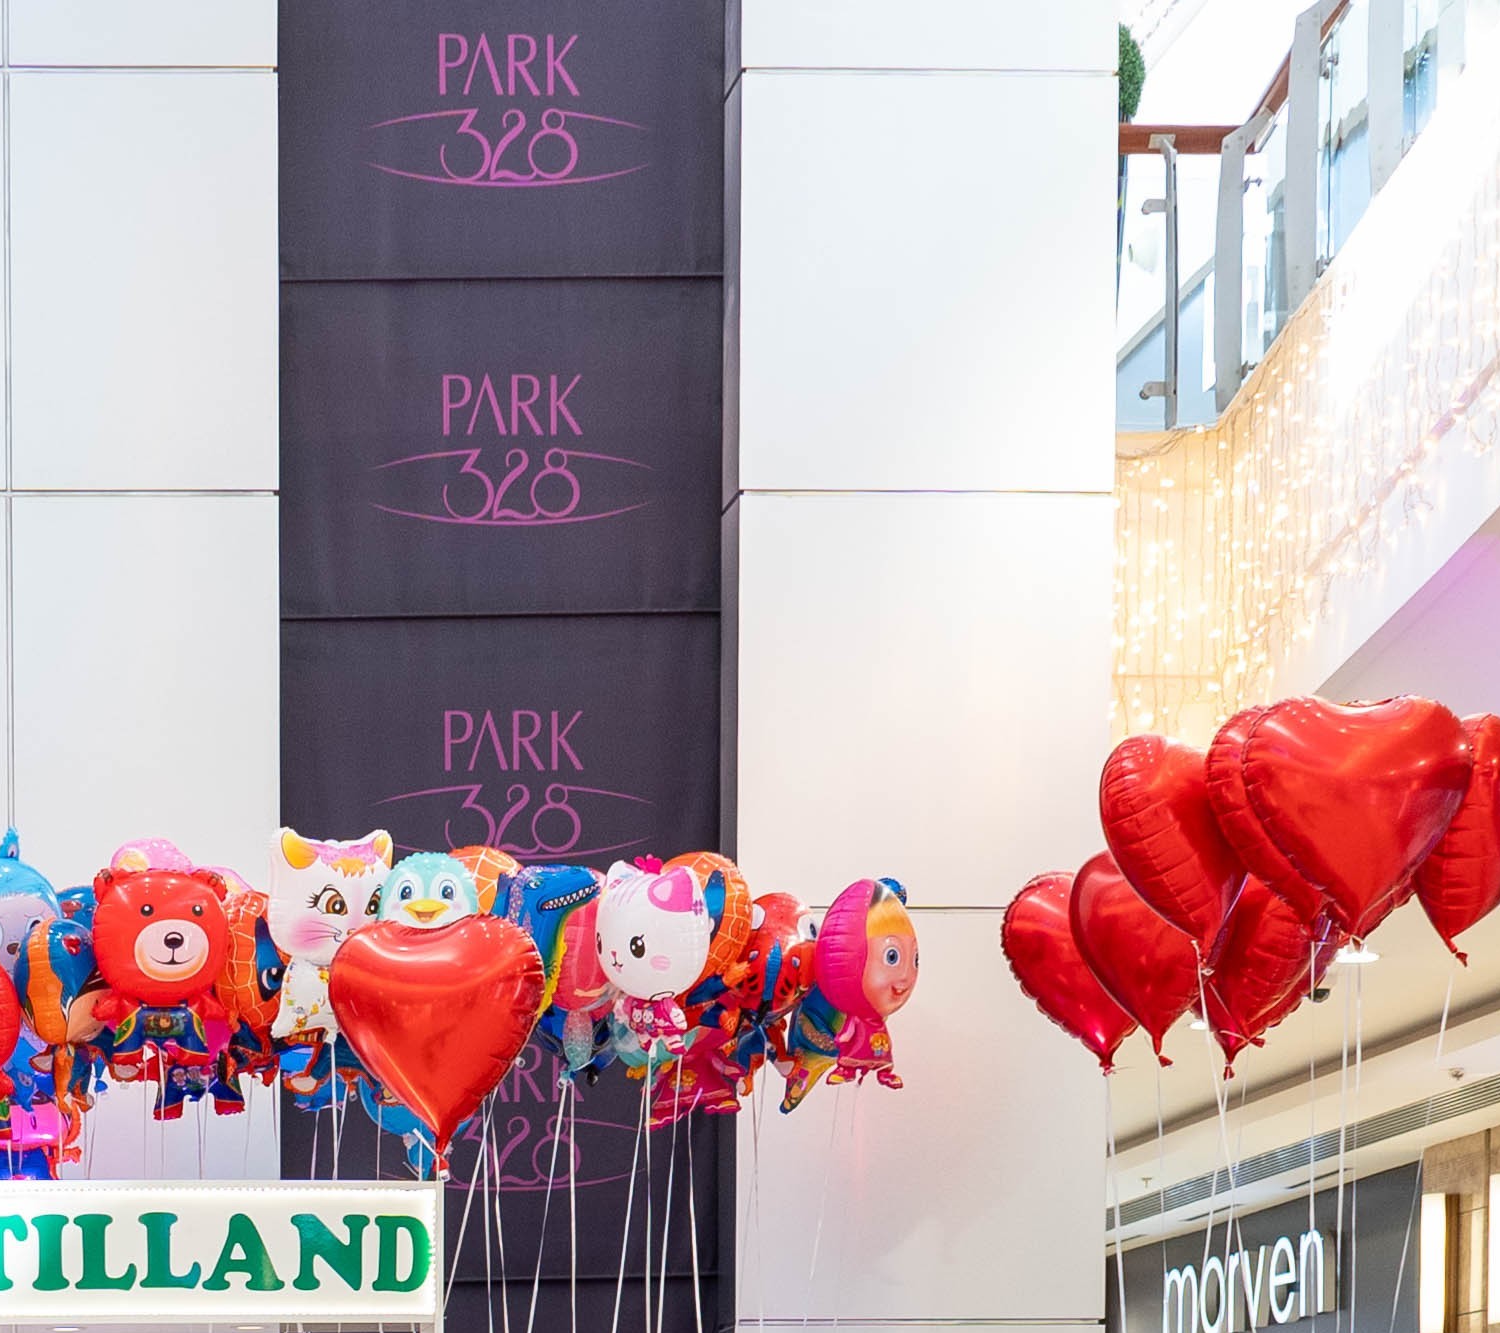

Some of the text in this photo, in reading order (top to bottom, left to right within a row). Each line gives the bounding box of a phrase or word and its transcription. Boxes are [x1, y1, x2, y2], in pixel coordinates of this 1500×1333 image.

[439, 33, 581, 96] PARK
[443, 108, 580, 183] 328
[441, 373, 583, 437] PARK
[443, 448, 580, 522] 328
[443, 710, 584, 771] PARK
[445, 784, 580, 858] 328
